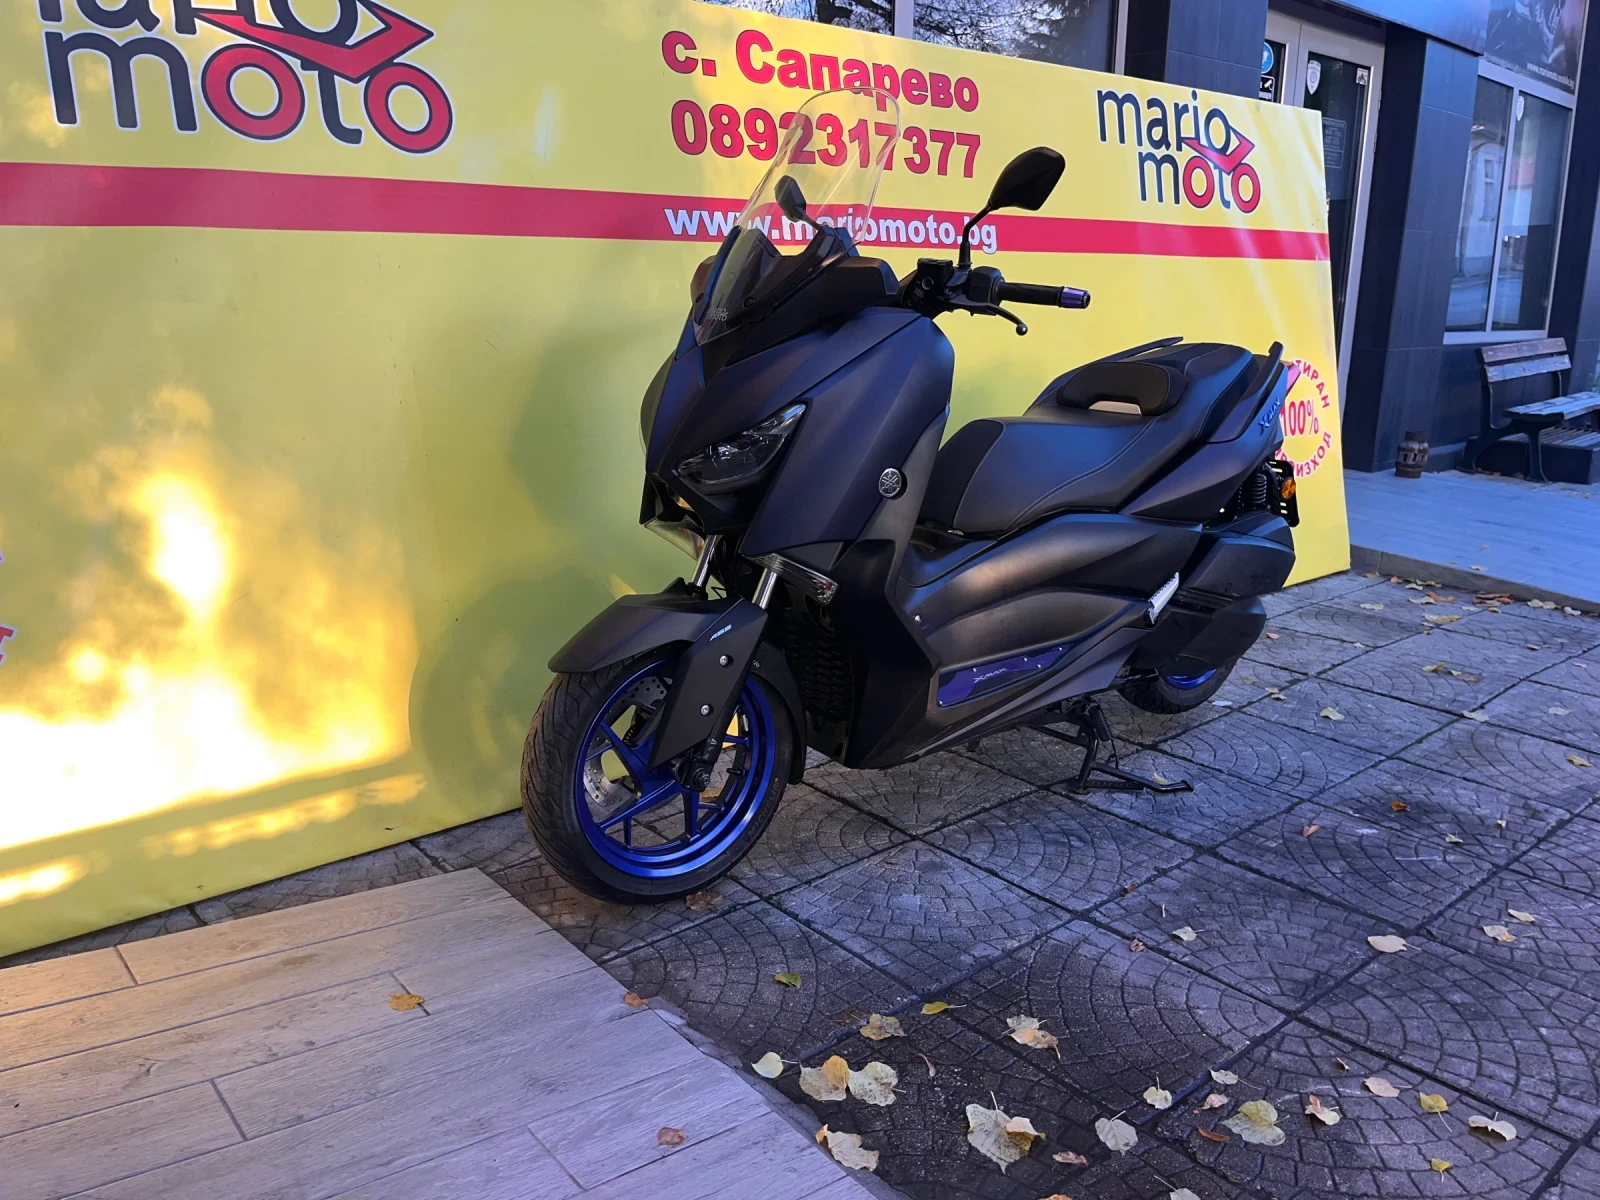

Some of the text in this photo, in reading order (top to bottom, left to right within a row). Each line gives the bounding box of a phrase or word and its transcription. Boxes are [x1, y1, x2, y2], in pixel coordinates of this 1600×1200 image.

[44, 31, 454, 155] moto
[661, 29, 980, 112] с. Сапарево
[670, 99, 982, 179] 0892317377
[1096, 89, 1233, 156] mario
[1137, 151, 1262, 214] moto
[1292, 359, 1330, 408] ТИРАН
[1279, 398, 1320, 437] 100%
